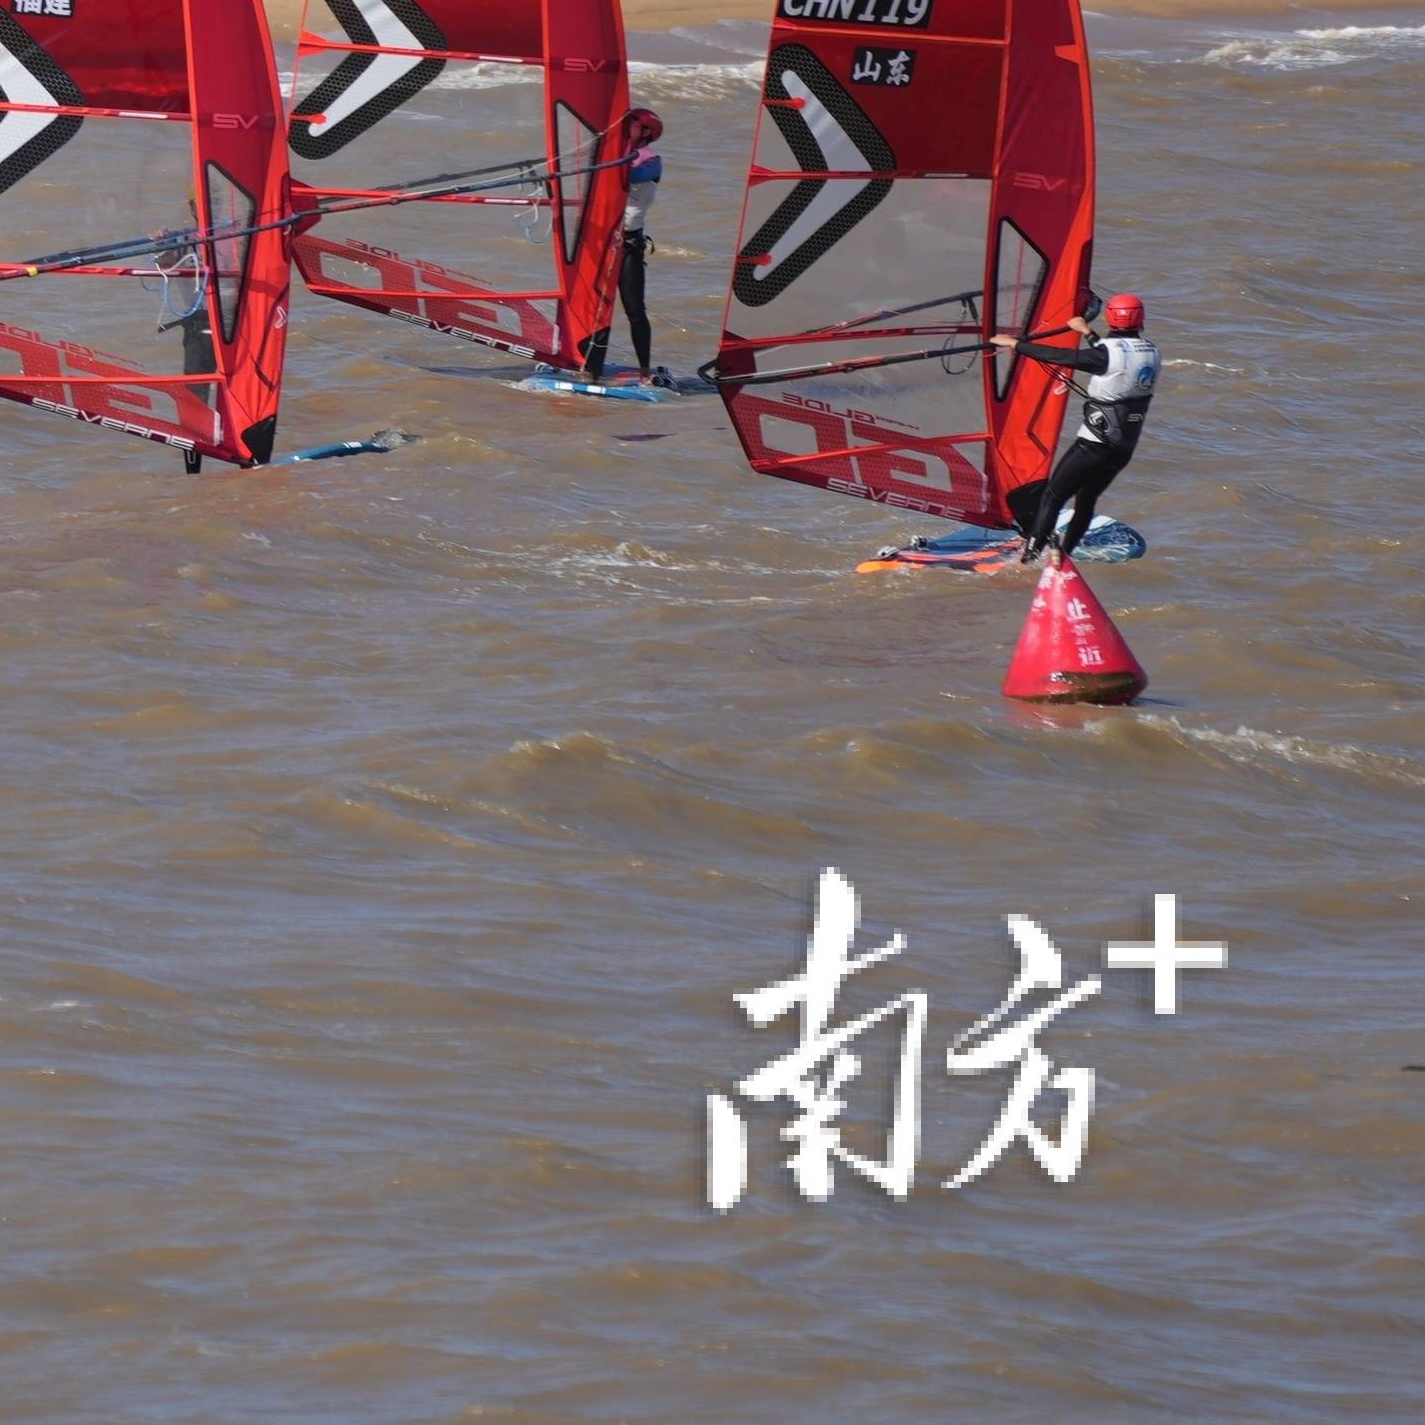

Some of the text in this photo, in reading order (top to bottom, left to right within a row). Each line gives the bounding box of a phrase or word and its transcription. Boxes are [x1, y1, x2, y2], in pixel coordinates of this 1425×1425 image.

[852, 50, 911, 86] 山东
[213, 114, 258, 129] SV
[388, 308, 536, 359] SEVERNE
[31, 397, 196, 451] SEVERNE
[826, 477, 966, 521] SEVERNE
